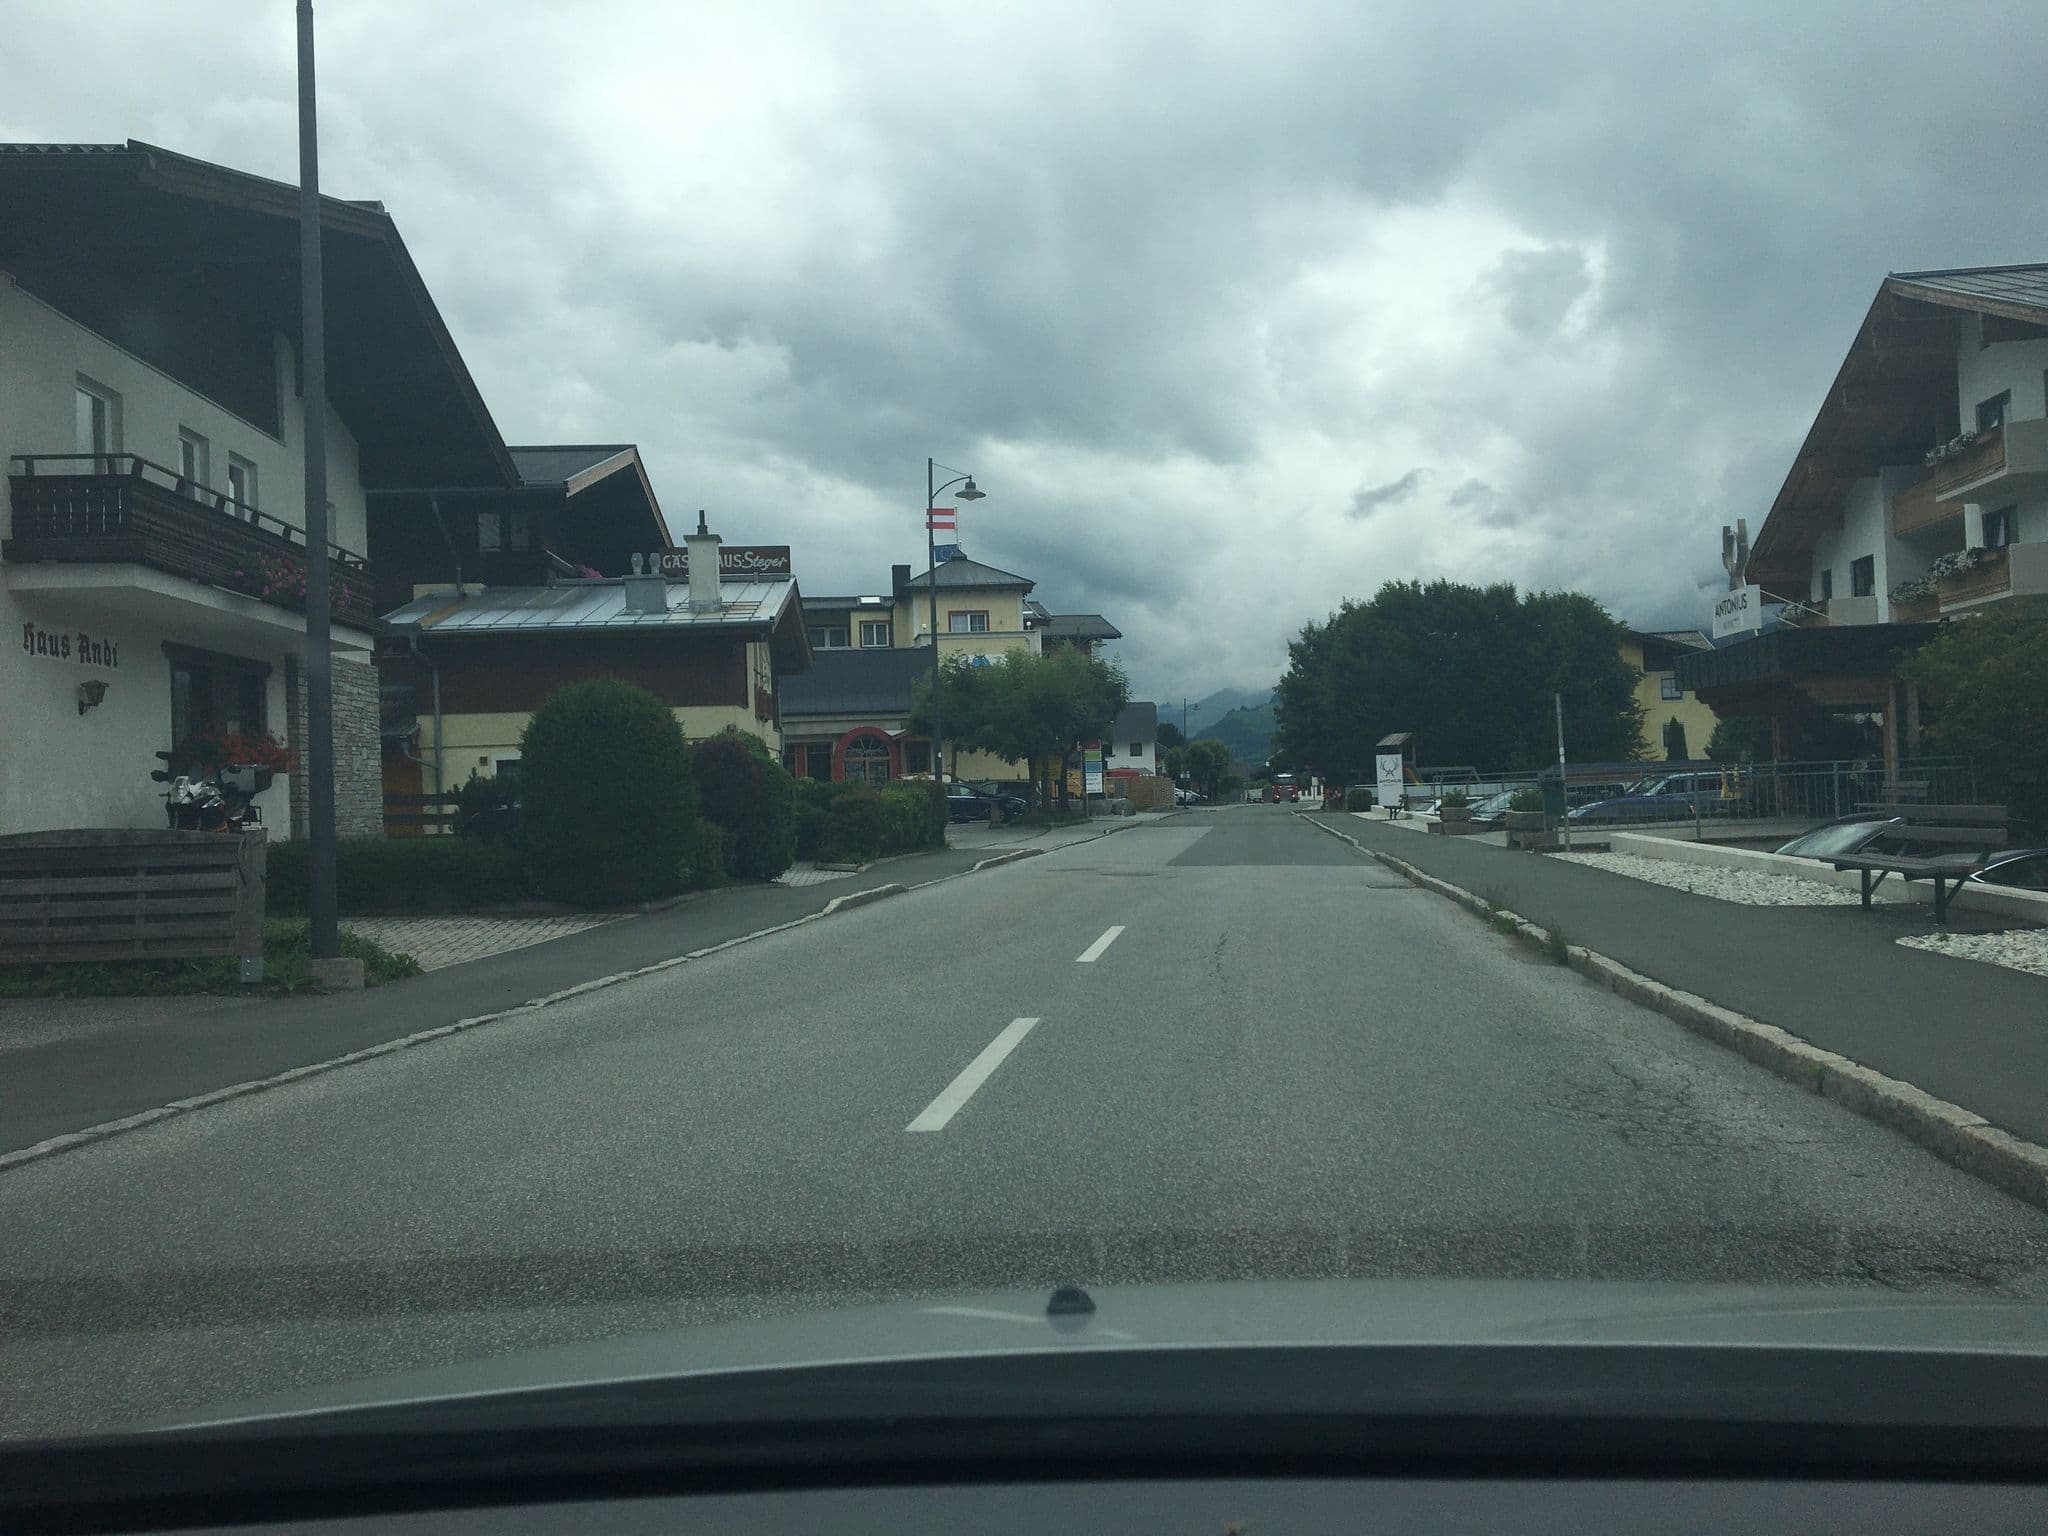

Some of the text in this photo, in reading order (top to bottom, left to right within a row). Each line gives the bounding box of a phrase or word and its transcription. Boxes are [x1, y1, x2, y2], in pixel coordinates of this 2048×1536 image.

[1715, 592, 1748, 618] ANTONIUS
[23, 621, 119, 668] Haus Andi
